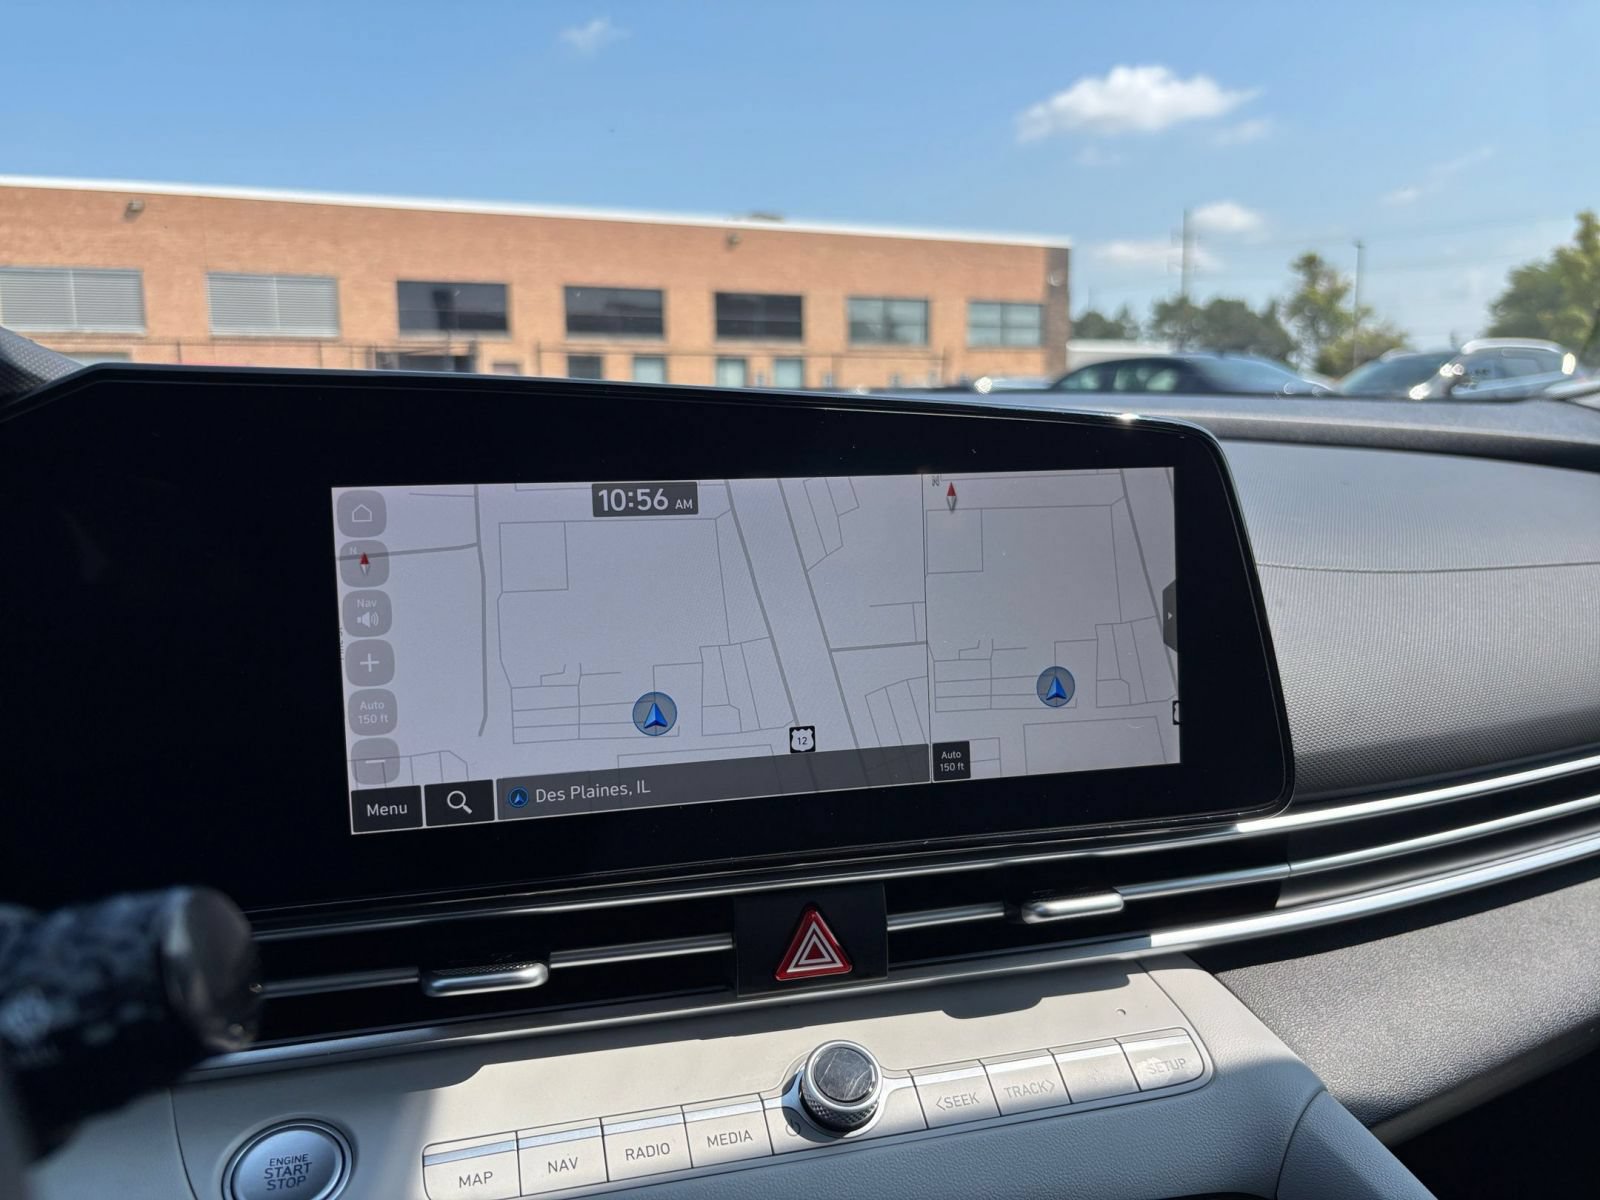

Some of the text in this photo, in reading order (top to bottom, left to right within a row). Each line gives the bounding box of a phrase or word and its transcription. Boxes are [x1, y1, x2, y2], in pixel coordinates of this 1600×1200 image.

[598, 488, 693, 512] 10:56 AM
[356, 598, 377, 609] Nav
[360, 700, 384, 710] Auto
[358, 714, 389, 724] 150 ft
[797, 736, 808, 745] 12
[941, 751, 962, 759] Auto
[940, 762, 965, 772] 150 ft
[535, 780, 651, 803] Des Plaines, IL
[366, 801, 408, 818] Menu
[1146, 1058, 1186, 1074] SETUP
[706, 1129, 754, 1149] MEDIA
[624, 1141, 671, 1162] RADIO
[269, 1153, 309, 1167] ENGINE
[547, 1156, 579, 1175] NAV
[264, 1162, 312, 1180] START
[266, 1175, 306, 1191] STOP
[458, 1170, 494, 1189] MAP
